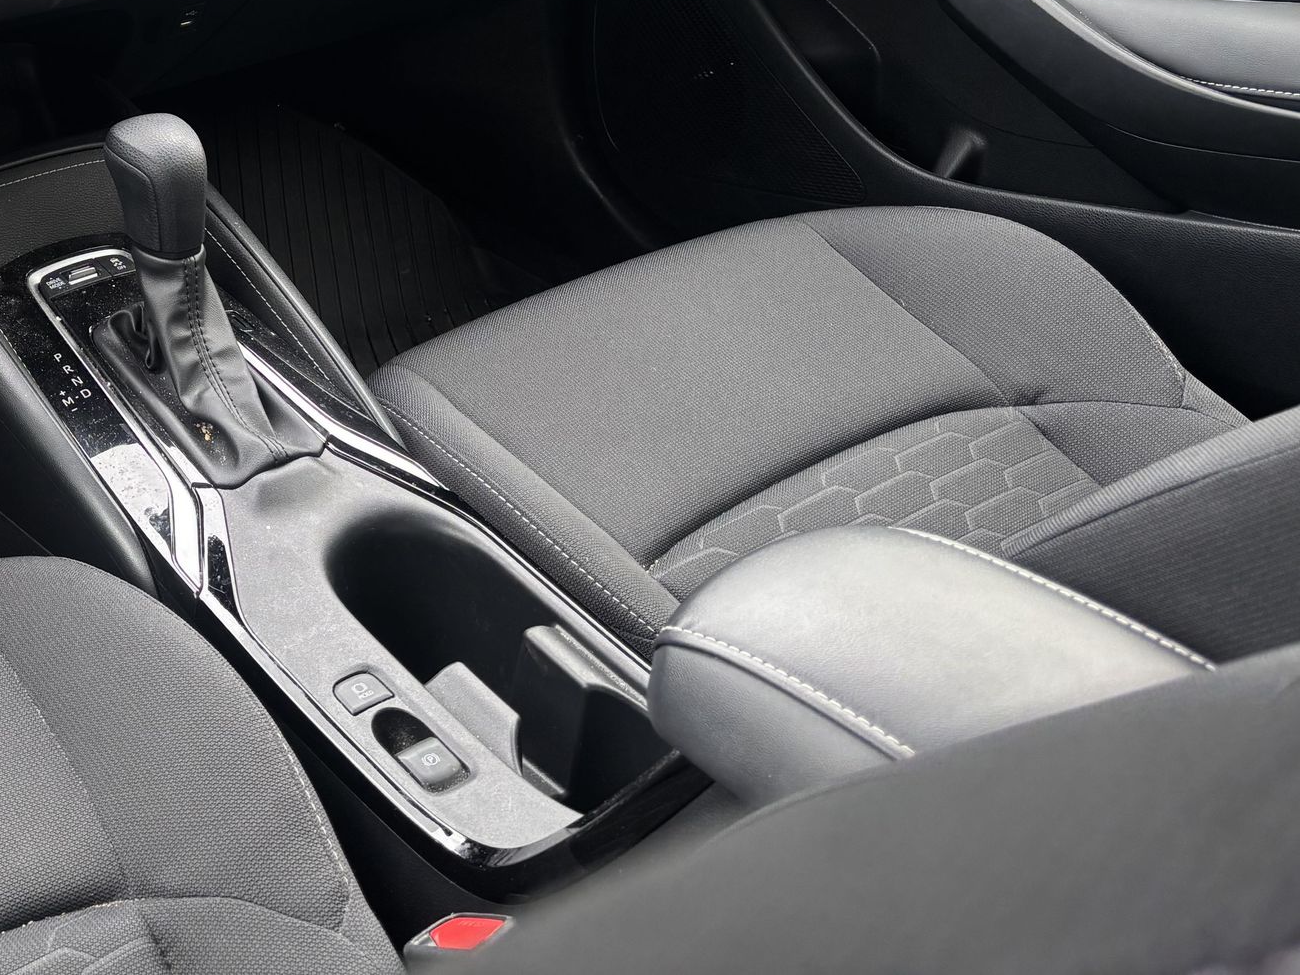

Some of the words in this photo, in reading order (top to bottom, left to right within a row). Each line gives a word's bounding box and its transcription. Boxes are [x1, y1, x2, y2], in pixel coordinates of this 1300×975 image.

[54, 353, 62, 362] P
[62, 365, 74, 374] R
[71, 376, 83, 386] N
